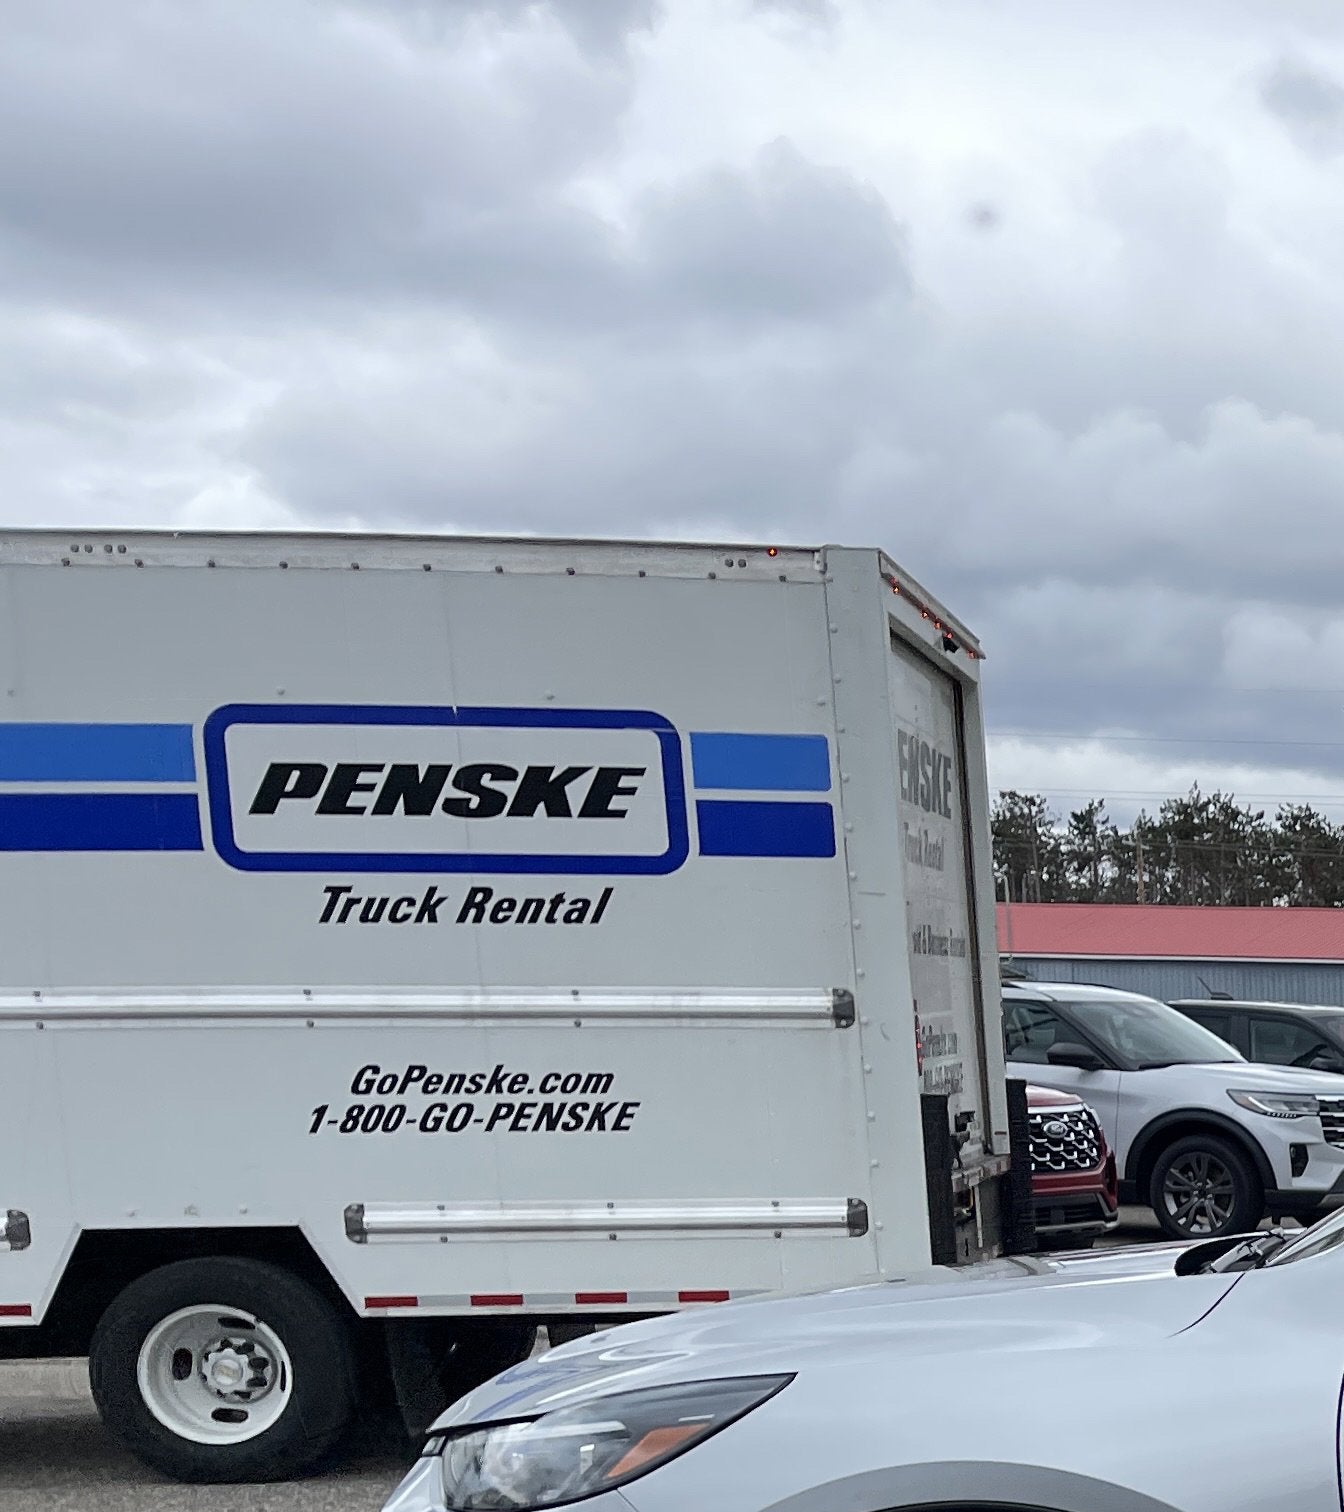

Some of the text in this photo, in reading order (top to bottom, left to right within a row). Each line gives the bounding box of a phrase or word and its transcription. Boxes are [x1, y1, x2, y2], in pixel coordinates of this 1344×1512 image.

[248, 761, 647, 820] PENSKE
[897, 728, 952, 820] ENSKE
[318, 885, 614, 925] Truck Rental
[350, 1064, 615, 1096] GoPenske.com
[309, 1101, 641, 1134] 1-800-GO-PENSKE
